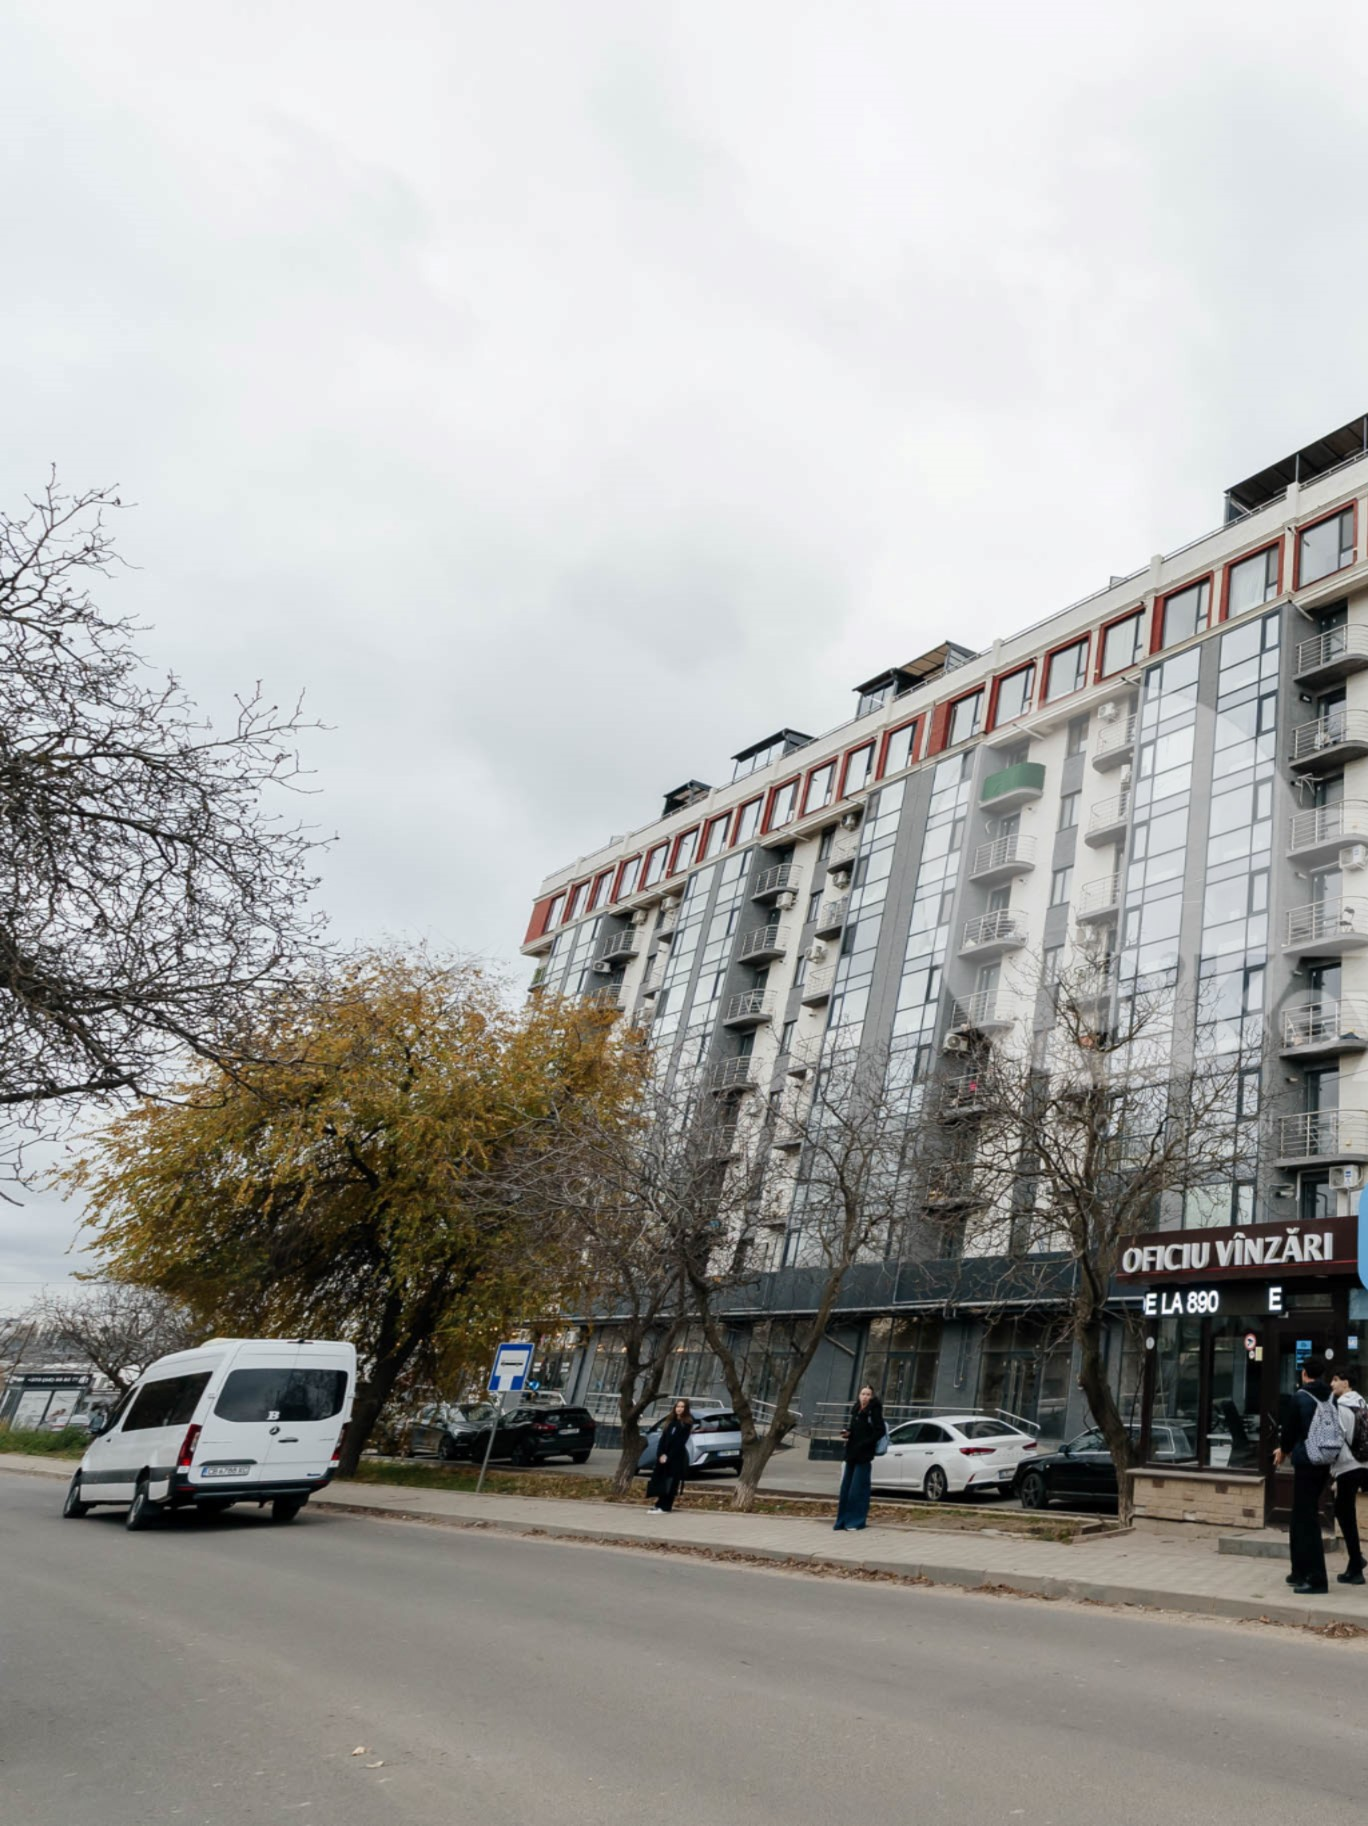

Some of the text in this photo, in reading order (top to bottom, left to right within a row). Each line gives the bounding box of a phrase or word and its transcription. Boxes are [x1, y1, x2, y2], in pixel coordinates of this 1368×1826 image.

[1122, 1227, 1334, 1274] OFICIU VÎNZĂRI
[1161, 1292, 1183, 1315] LA
[1186, 1290, 1219, 1314] 890
